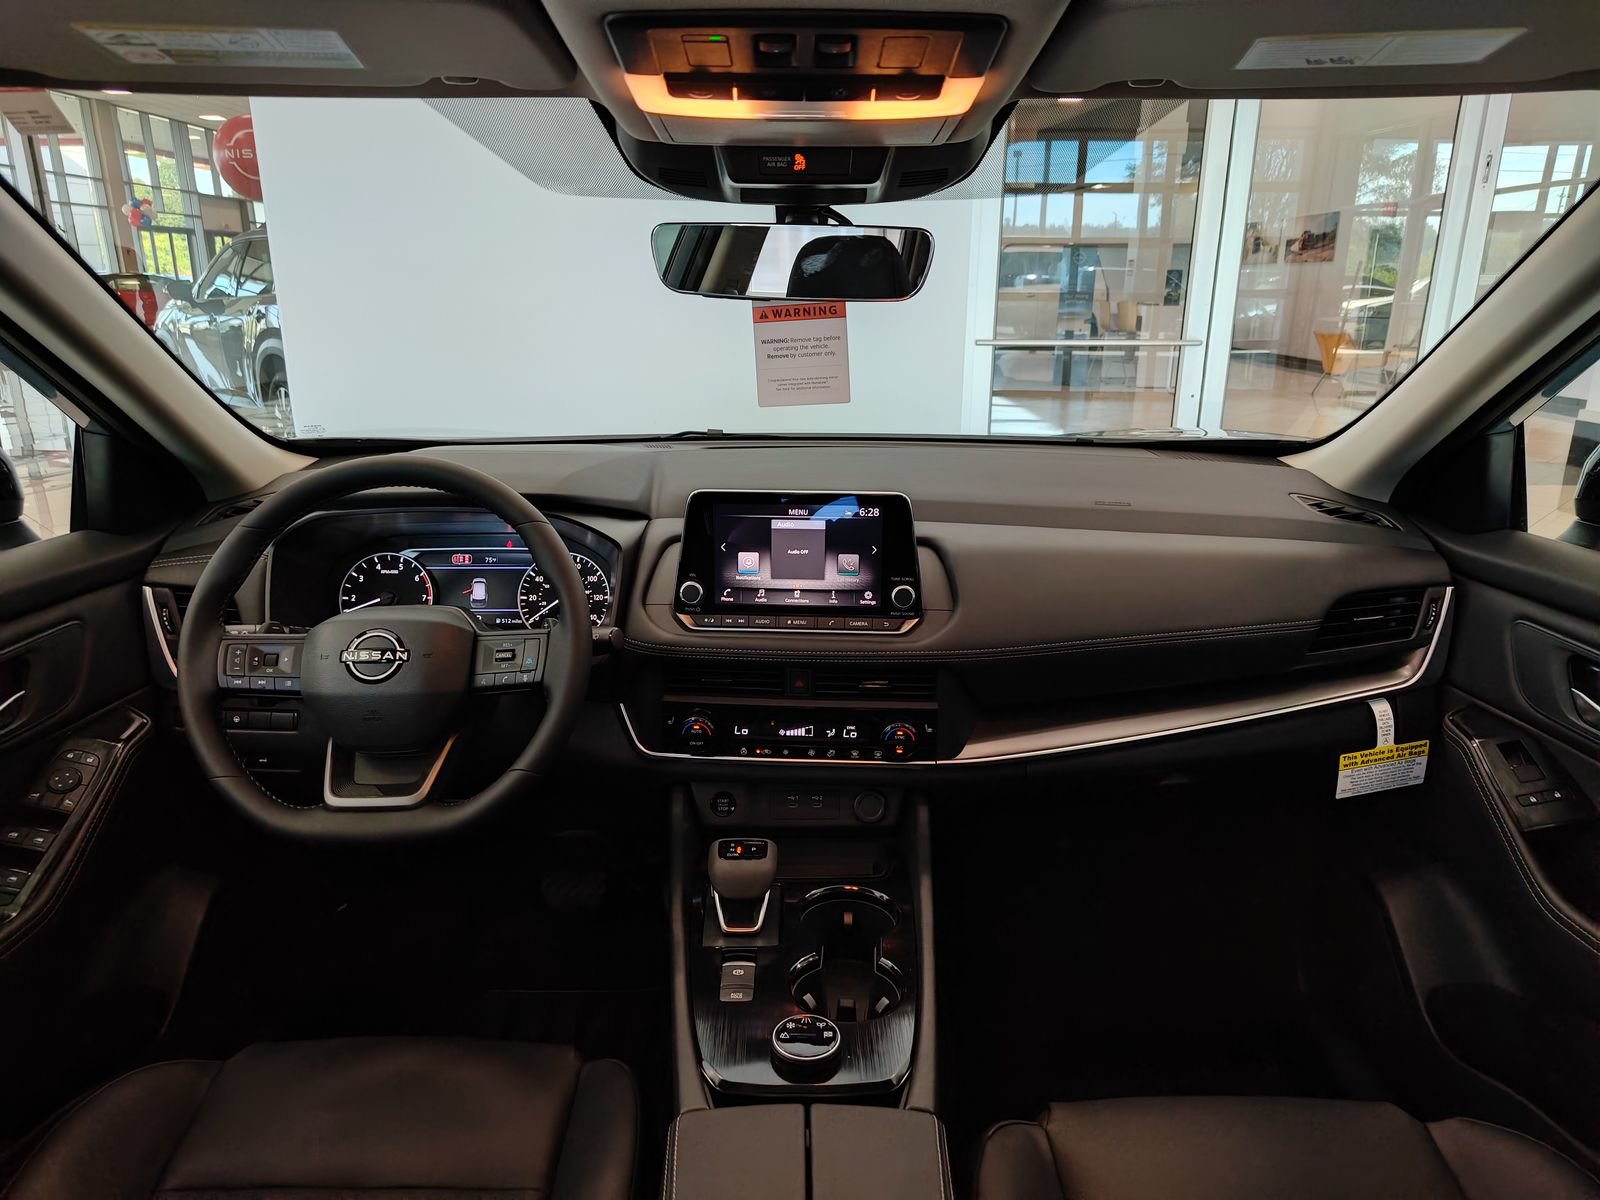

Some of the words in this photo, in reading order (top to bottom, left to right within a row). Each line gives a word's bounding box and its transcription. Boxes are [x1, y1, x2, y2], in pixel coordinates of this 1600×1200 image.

[772, 305, 837, 319] WARNING
[813, 335, 822, 343] tag
[859, 508, 880, 517] 6:28
[343, 651, 408, 661] NISSAN
[734, 725, 749, 735] Lo
[842, 729, 858, 738] Lo
[1360, 750, 1385, 759] Vehicle
[1396, 742, 1428, 752] Equipped
[1343, 760, 1359, 768] with
[1360, 754, 1395, 765] Advanced
[1396, 752, 1407, 760] Air
